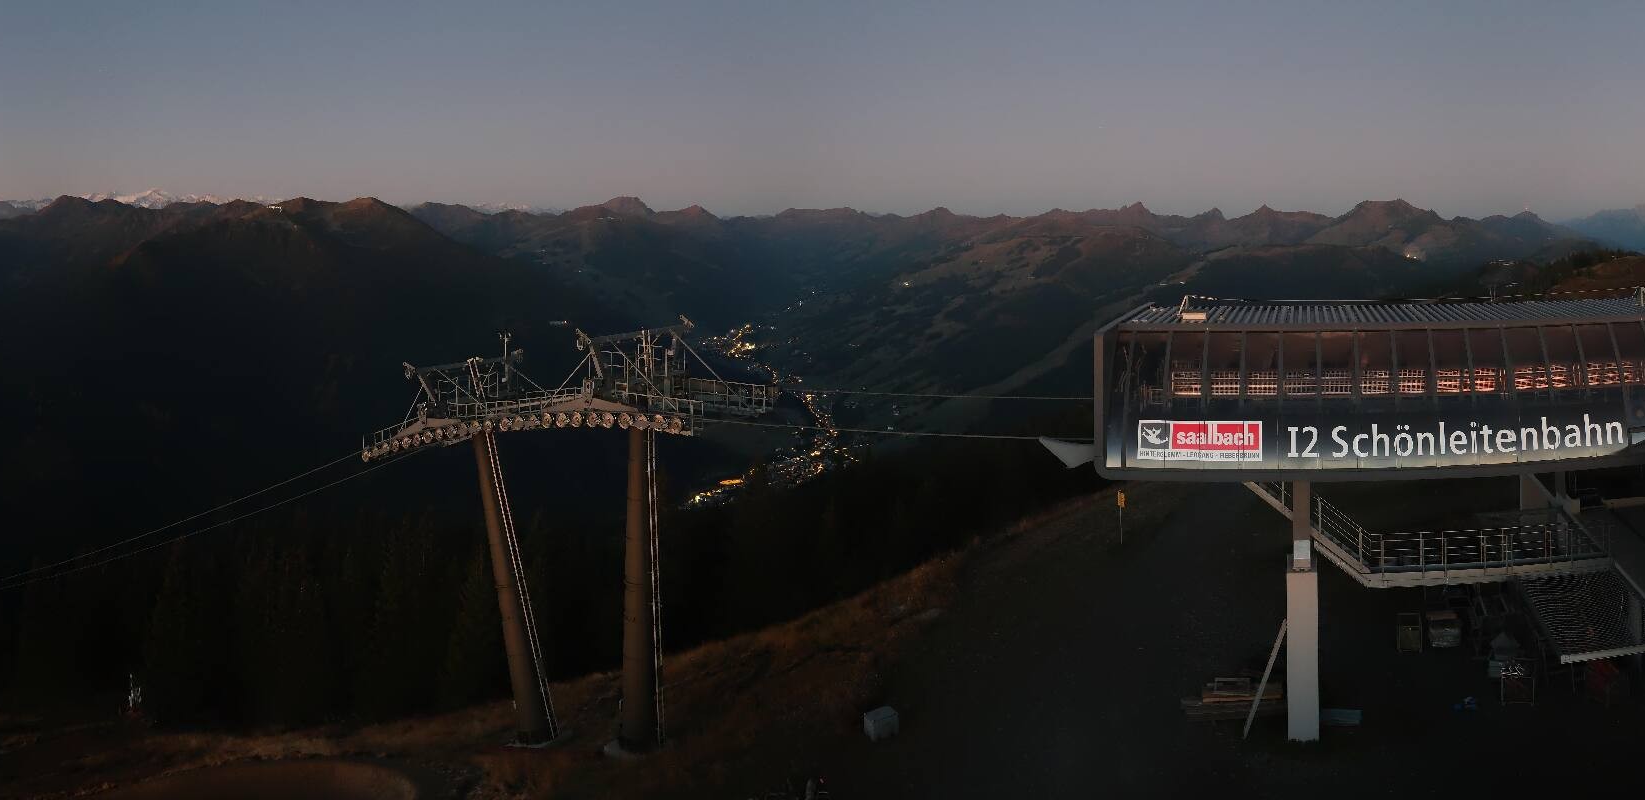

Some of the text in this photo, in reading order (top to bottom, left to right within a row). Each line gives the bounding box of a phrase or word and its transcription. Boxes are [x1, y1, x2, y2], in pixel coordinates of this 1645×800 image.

[1176, 423, 1255, 446] saalbach
[1287, 413, 1625, 458] I2 Schönleitenbahn
